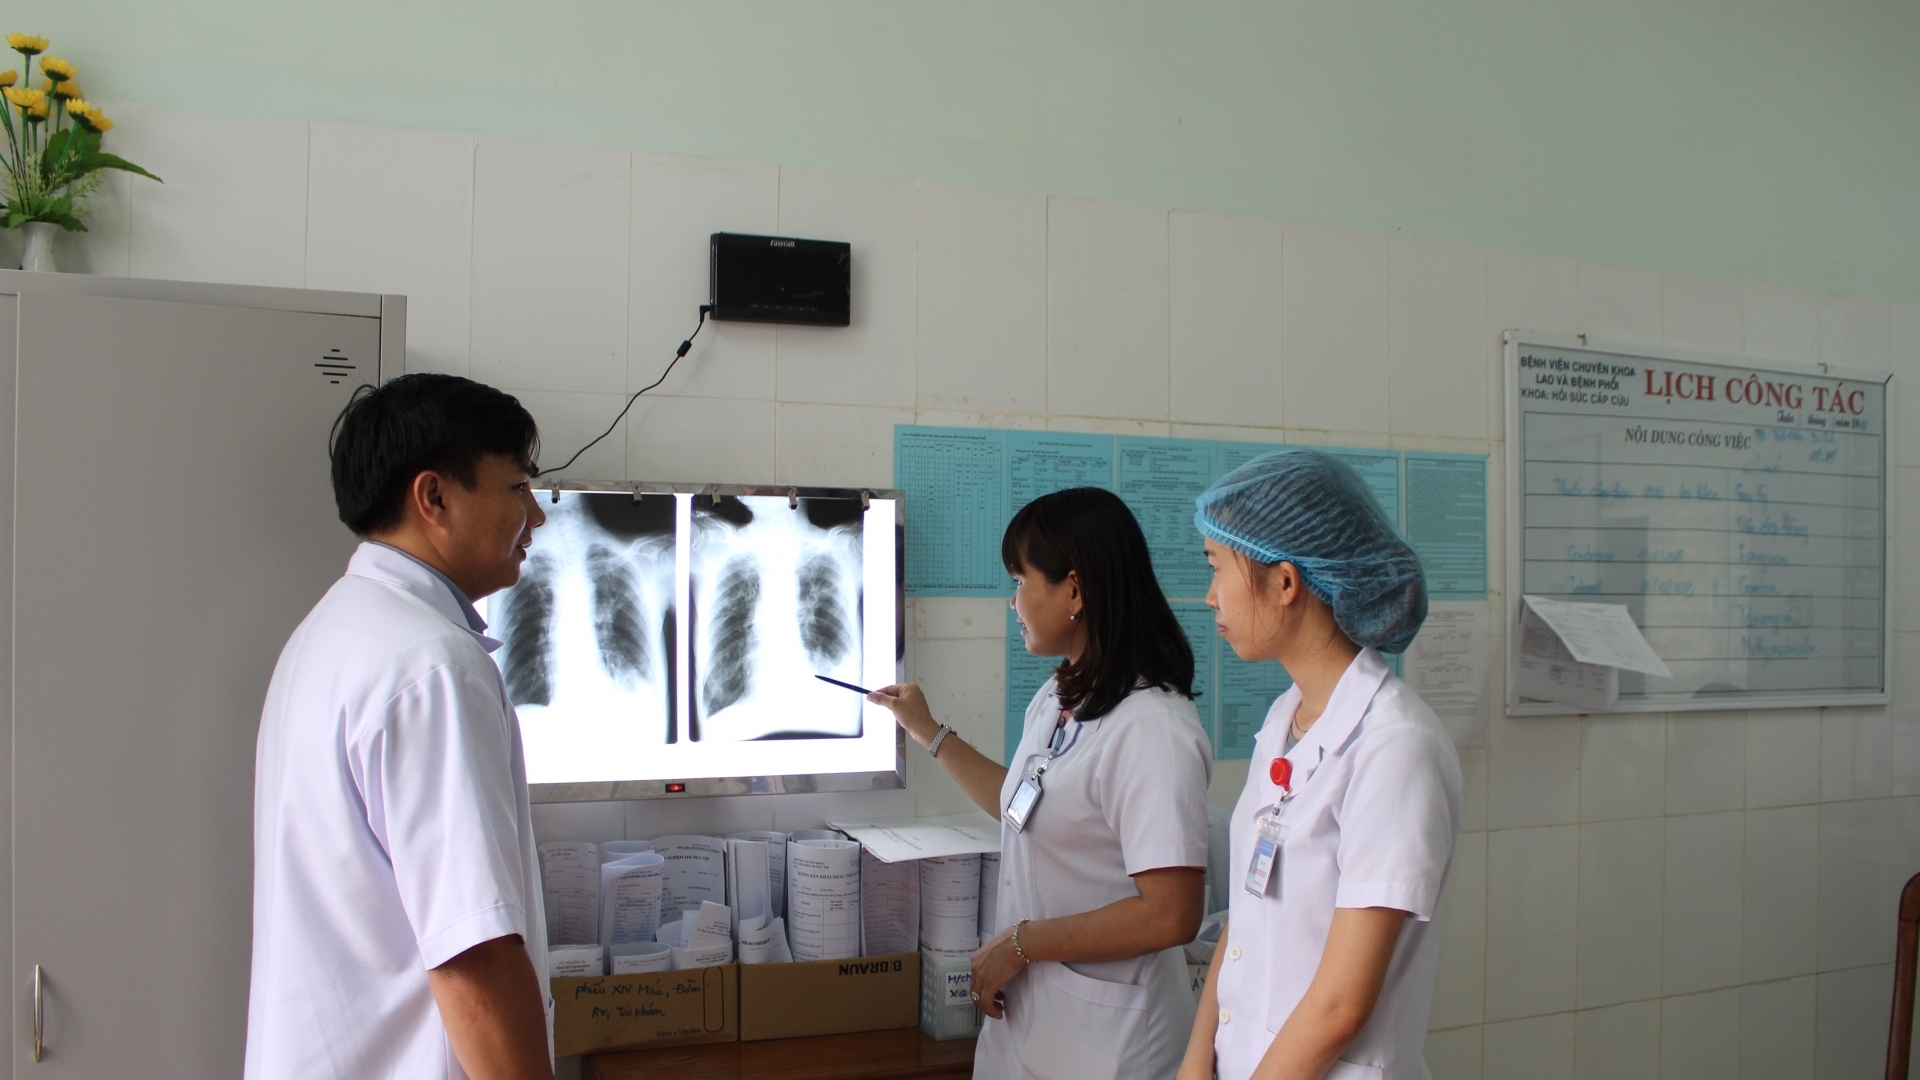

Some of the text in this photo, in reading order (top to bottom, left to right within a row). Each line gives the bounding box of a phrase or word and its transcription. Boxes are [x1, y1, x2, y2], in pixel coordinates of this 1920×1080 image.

[1521, 355, 1636, 377] BỆNH VIỆN CHUYÊN KHOA
[1536, 374, 1554, 385] LAO
[1556, 373, 1568, 385] VÀ
[1571, 375, 1596, 388] BỆNH
[1521, 388, 1549, 399] KHOA:
[1591, 391, 1608, 404] CẤP
[1644, 369, 1865, 415] LỊCH CÔNG TÁC
[1624, 426, 1648, 444] NỘI
[1651, 429, 1685, 446] DUNG
[1689, 429, 1721, 448] CÔNG
[1725, 432, 1751, 451] VIỆC
[839, 960, 902, 976] B BRAUN
[948, 973, 971, 986] H/ch
[575, 979, 607, 1000] phiếu
[612, 983, 633, 996] XN
[617, 1004, 633, 1018] Tái
